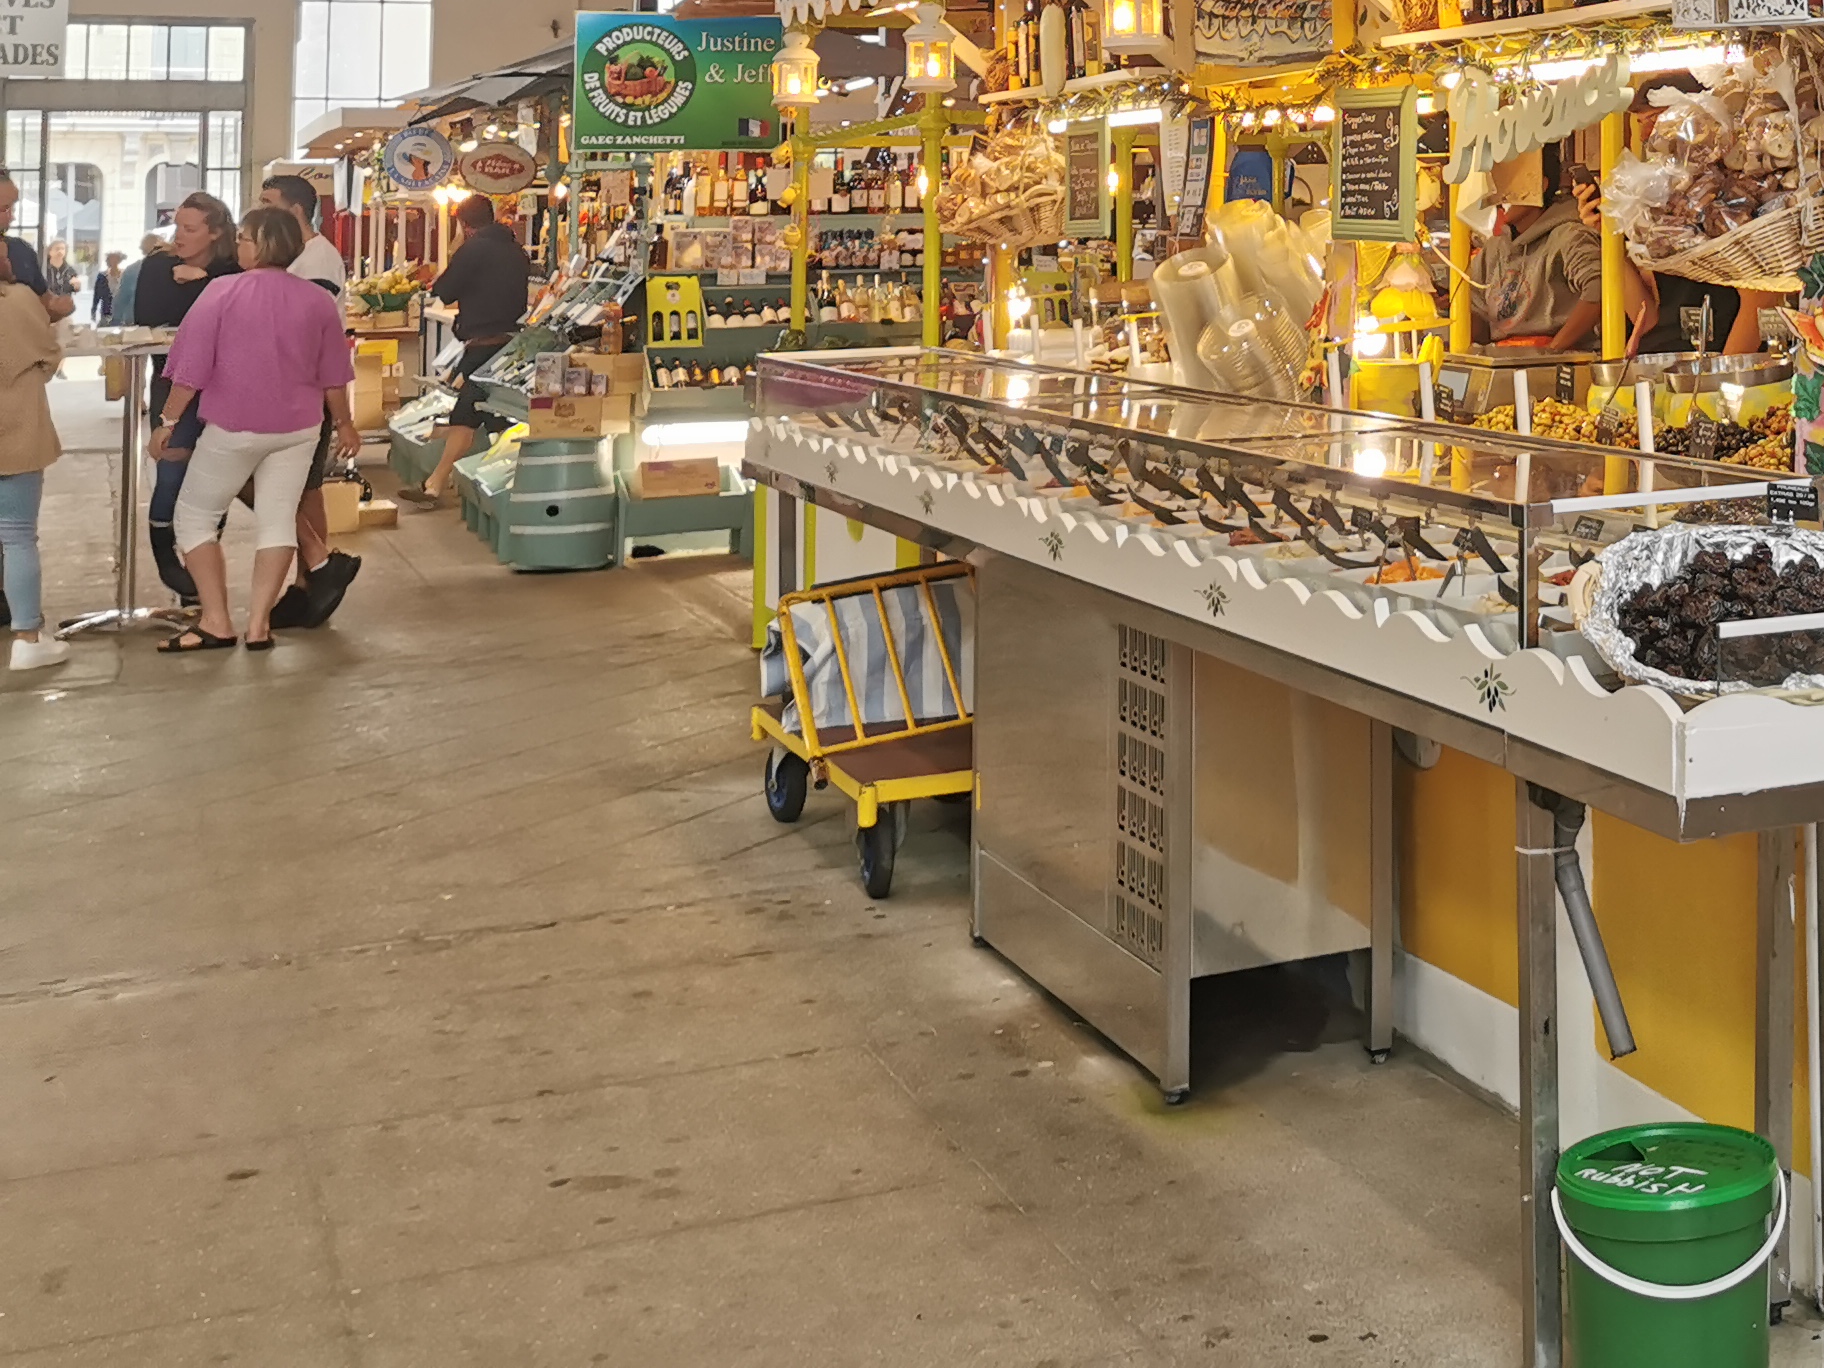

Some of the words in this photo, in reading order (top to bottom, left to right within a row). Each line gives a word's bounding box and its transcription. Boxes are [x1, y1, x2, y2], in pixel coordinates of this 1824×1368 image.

[594, 25, 690, 62] PRODUCTEURS
[697, 32, 776, 53] Justine
[583, 72, 600, 91] DE
[704, 62, 726, 84] &
[587, 88, 627, 125] FRUITS
[644, 79, 694, 125] LÉGUMES
[627, 111, 643, 126] ET
